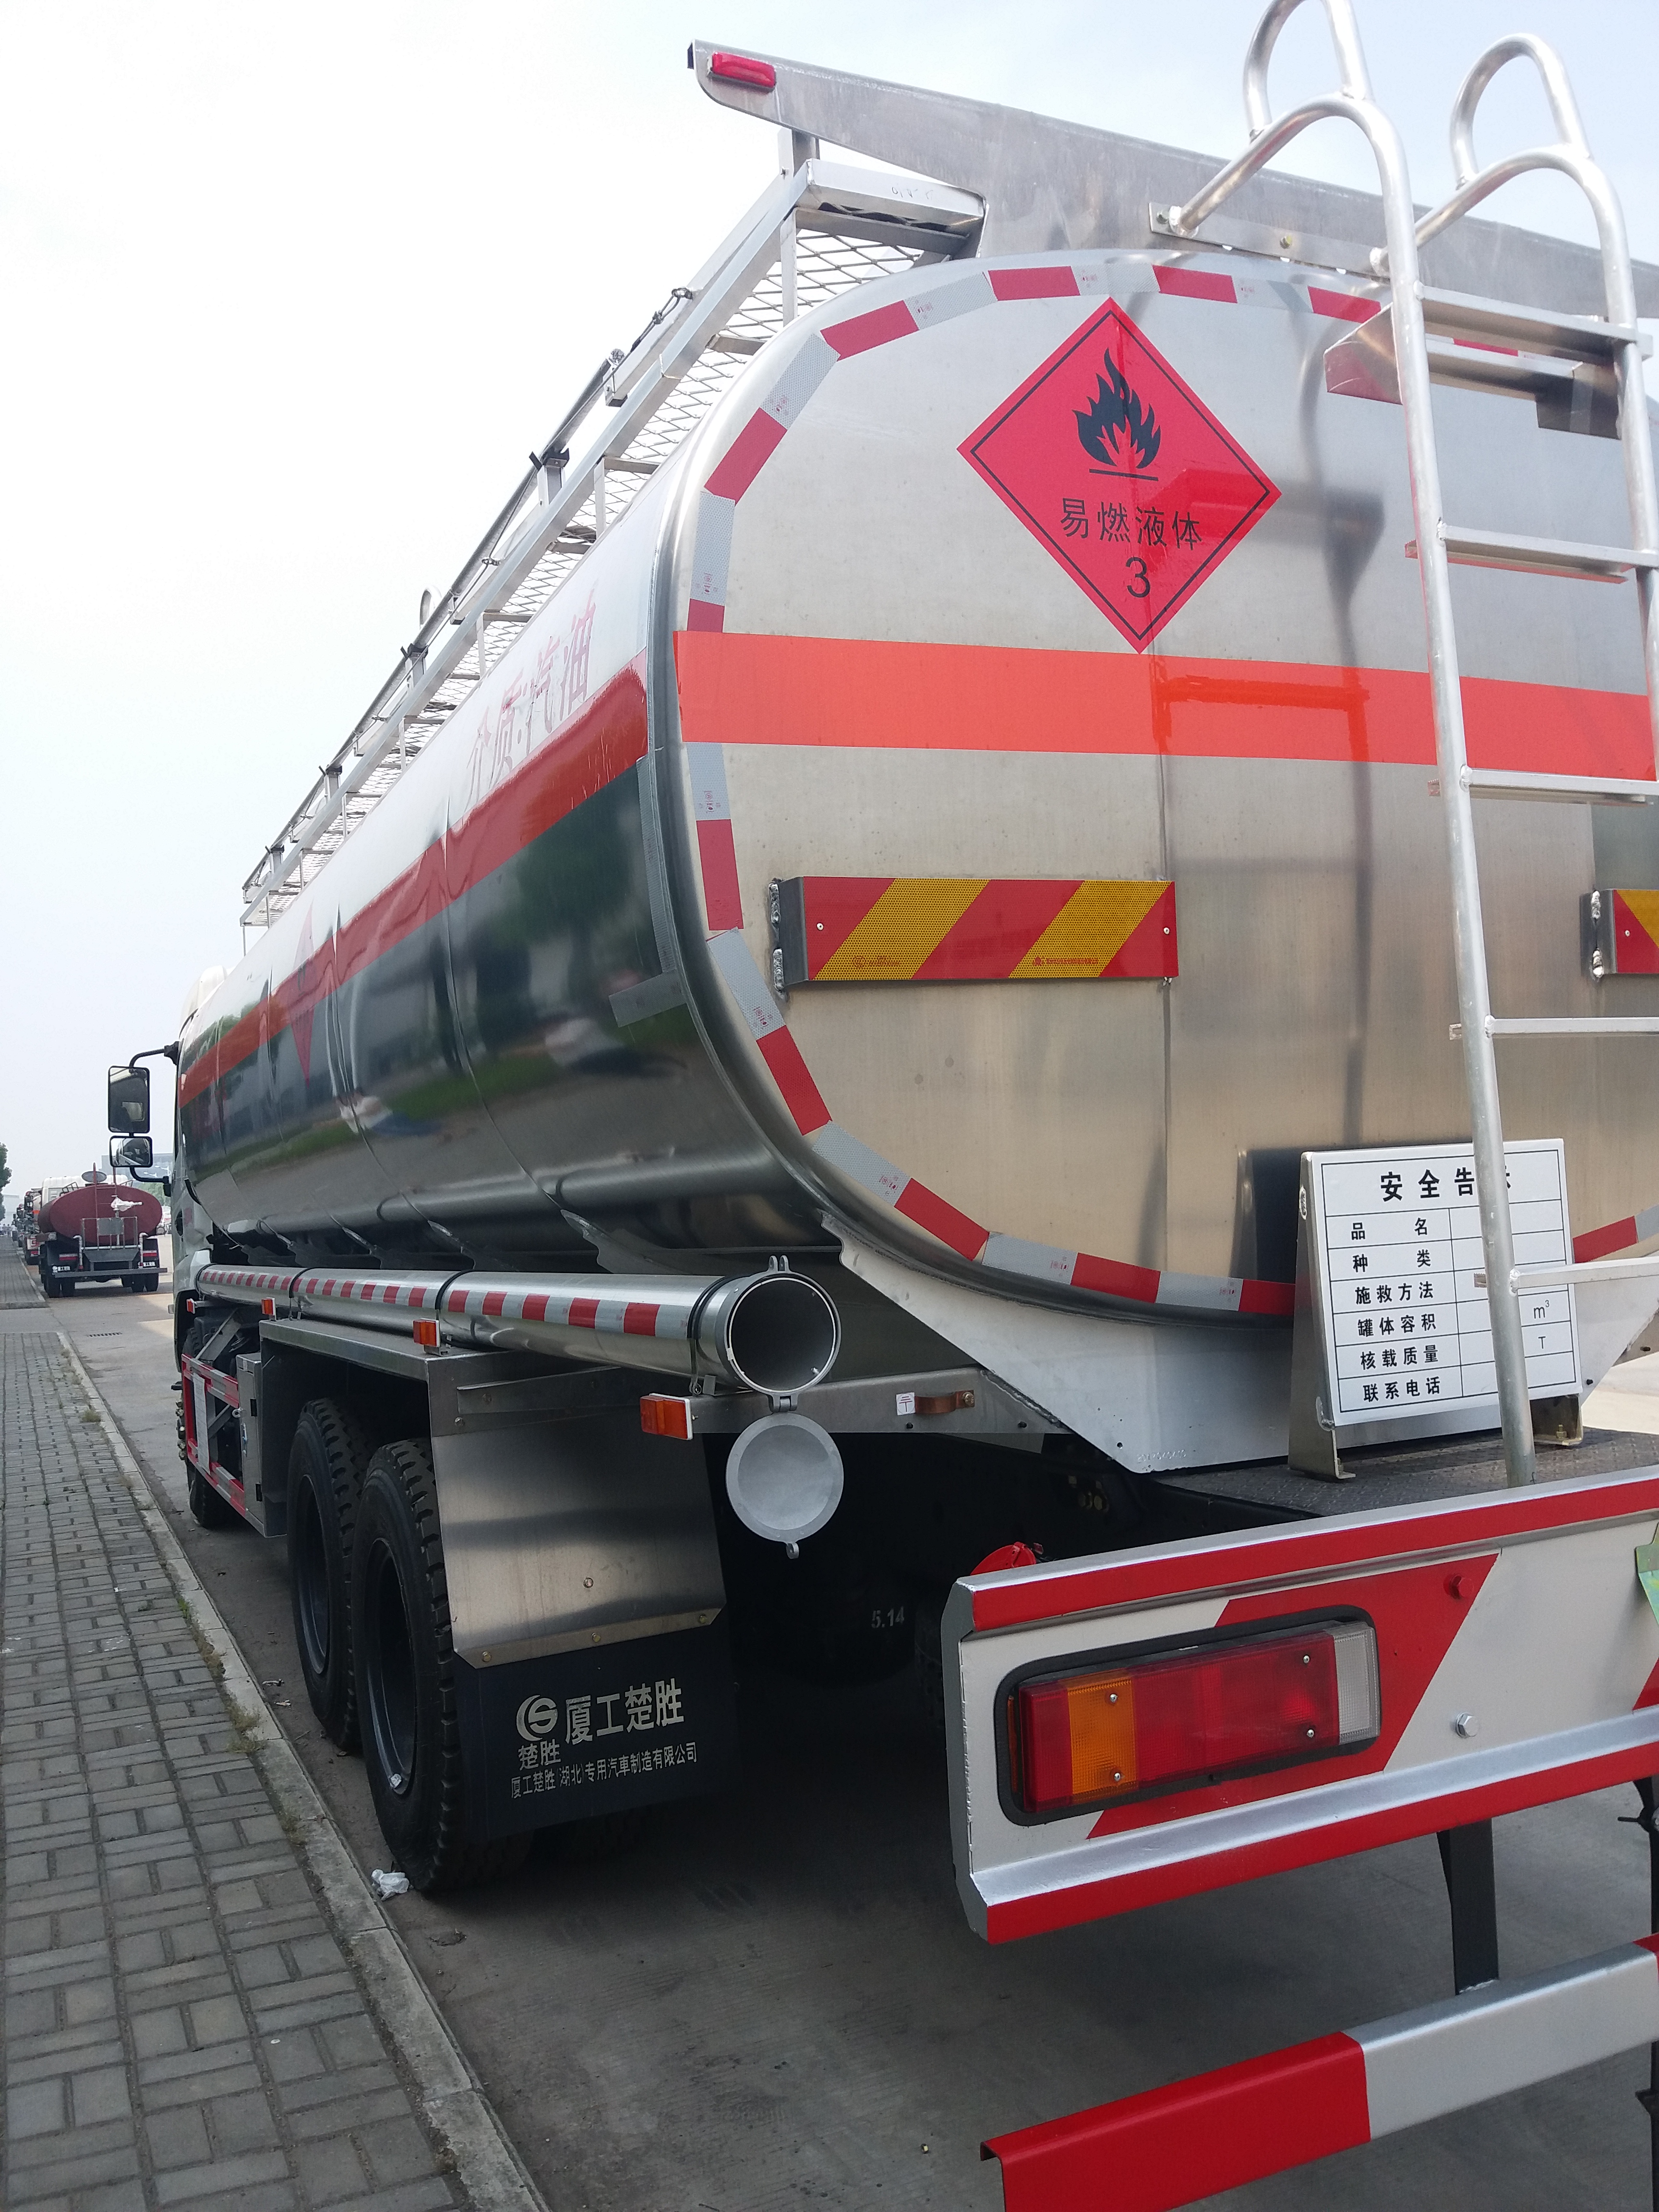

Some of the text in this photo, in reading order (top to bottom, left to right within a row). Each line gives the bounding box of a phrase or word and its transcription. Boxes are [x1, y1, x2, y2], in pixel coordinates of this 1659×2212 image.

[1060, 497, 1202, 551] 易燃液体
[1125, 557, 1151, 598] 3
[1380, 1166, 1511, 1202] 安全告
[1354, 1281, 1434, 1305] 施救方法
[1357, 1312, 1437, 1338] 罐体容积
[1538, 1335, 1546, 1349] T
[1360, 1345, 1439, 1370] 核载质量
[1362, 1376, 1441, 1402] 联系电话
[565, 1677, 685, 1745] 厦工楚胜
[517, 1738, 562, 1771] 楚胜
